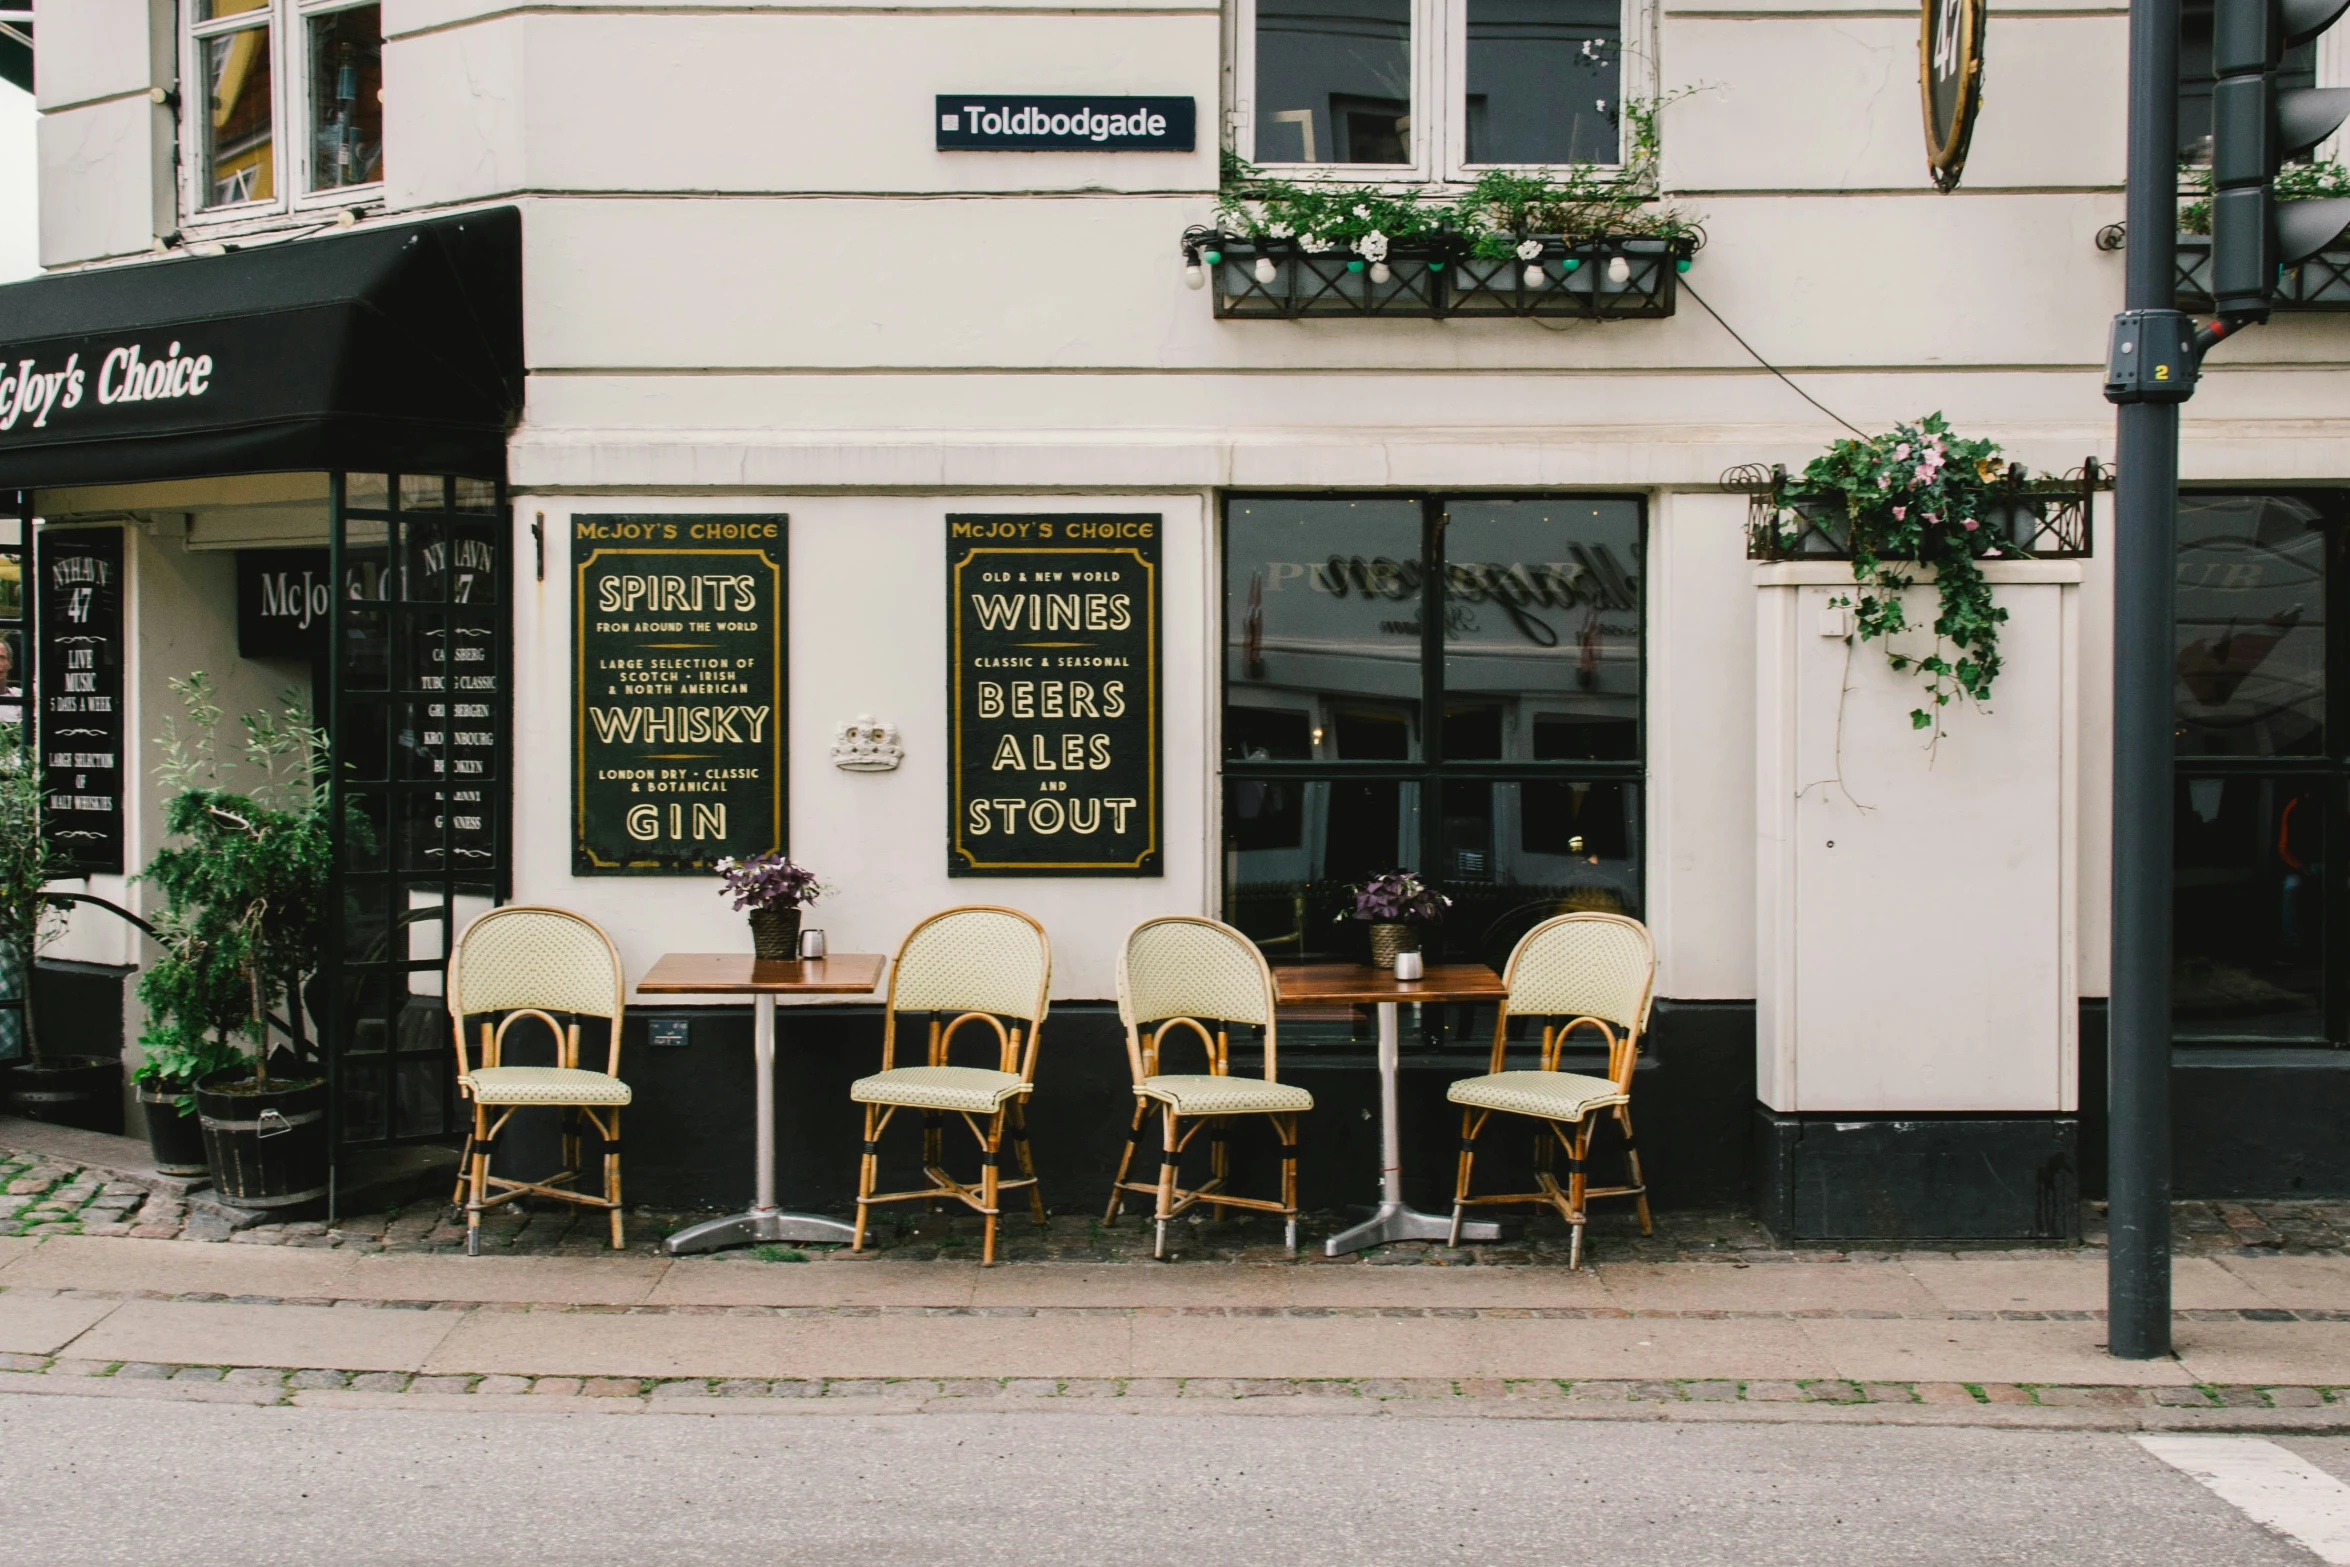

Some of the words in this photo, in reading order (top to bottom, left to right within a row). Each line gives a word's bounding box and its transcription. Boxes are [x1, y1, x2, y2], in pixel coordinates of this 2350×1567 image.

[963, 105, 1167, 142] Toldbodgade
[2154, 364, 2169, 380] 2
[0, 352, 86, 431] cJoy's
[98, 341, 213, 405] Choice
[576, 522, 678, 540] McJOY'S
[689, 523, 778, 540] CHOICE
[951, 521, 1053, 538] McJOY'S
[1065, 522, 1154, 539] CHOICE
[982, 572, 1011, 582] OLD
[1018, 572, 1028, 582] &
[1035, 572, 1063, 582] NEW
[1071, 572, 1121, 582] WORLD
[598, 574, 756, 613] SPIRITS
[68, 588, 92, 623] 47
[971, 593, 1131, 631] WINES
[634, 622, 684, 633] AROUND
[688, 621, 711, 632] THE
[716, 621, 759, 632] WORLD
[68, 650, 94, 669] LIVE
[600, 659, 644, 669] LARGE
[650, 658, 729, 669] SELECTION
[735, 658, 755, 669] OF
[974, 657, 1033, 668] CLASSIC
[1040, 657, 1050, 667] &
[1057, 656, 1130, 667] SEASONAL
[64, 672, 97, 692] MUSIC
[460, 676, 497, 689] CLASSIC
[619, 671, 679, 682] SCOTCH
[699, 671, 736, 681] IRISH
[608, 685, 617, 695] &
[624, 684, 673, 695] NORTH
[680, 683, 748, 694] AMERICAN
[50, 697, 56, 712] 5
[57, 696, 77, 712] DAYS
[79, 696, 86, 712] A
[87, 696, 112, 712] WEEK
[978, 680, 1126, 719] BEERS
[588, 705, 770, 744] WHISKY
[49, 753, 72, 767] LARGE
[74, 753, 114, 768] SELECTION
[991, 733, 1111, 771] ALES
[75, 774, 86, 789] OF
[598, 769, 655, 780] LONDON
[661, 769, 687, 780] DRY
[705, 768, 759, 779] CLASSIC
[630, 782, 640, 793] &
[647, 781, 727, 793] BOTANICAL
[1039, 780, 1067, 792] AND
[626, 802, 727, 841] GIN
[969, 797, 1137, 836] STOUT
